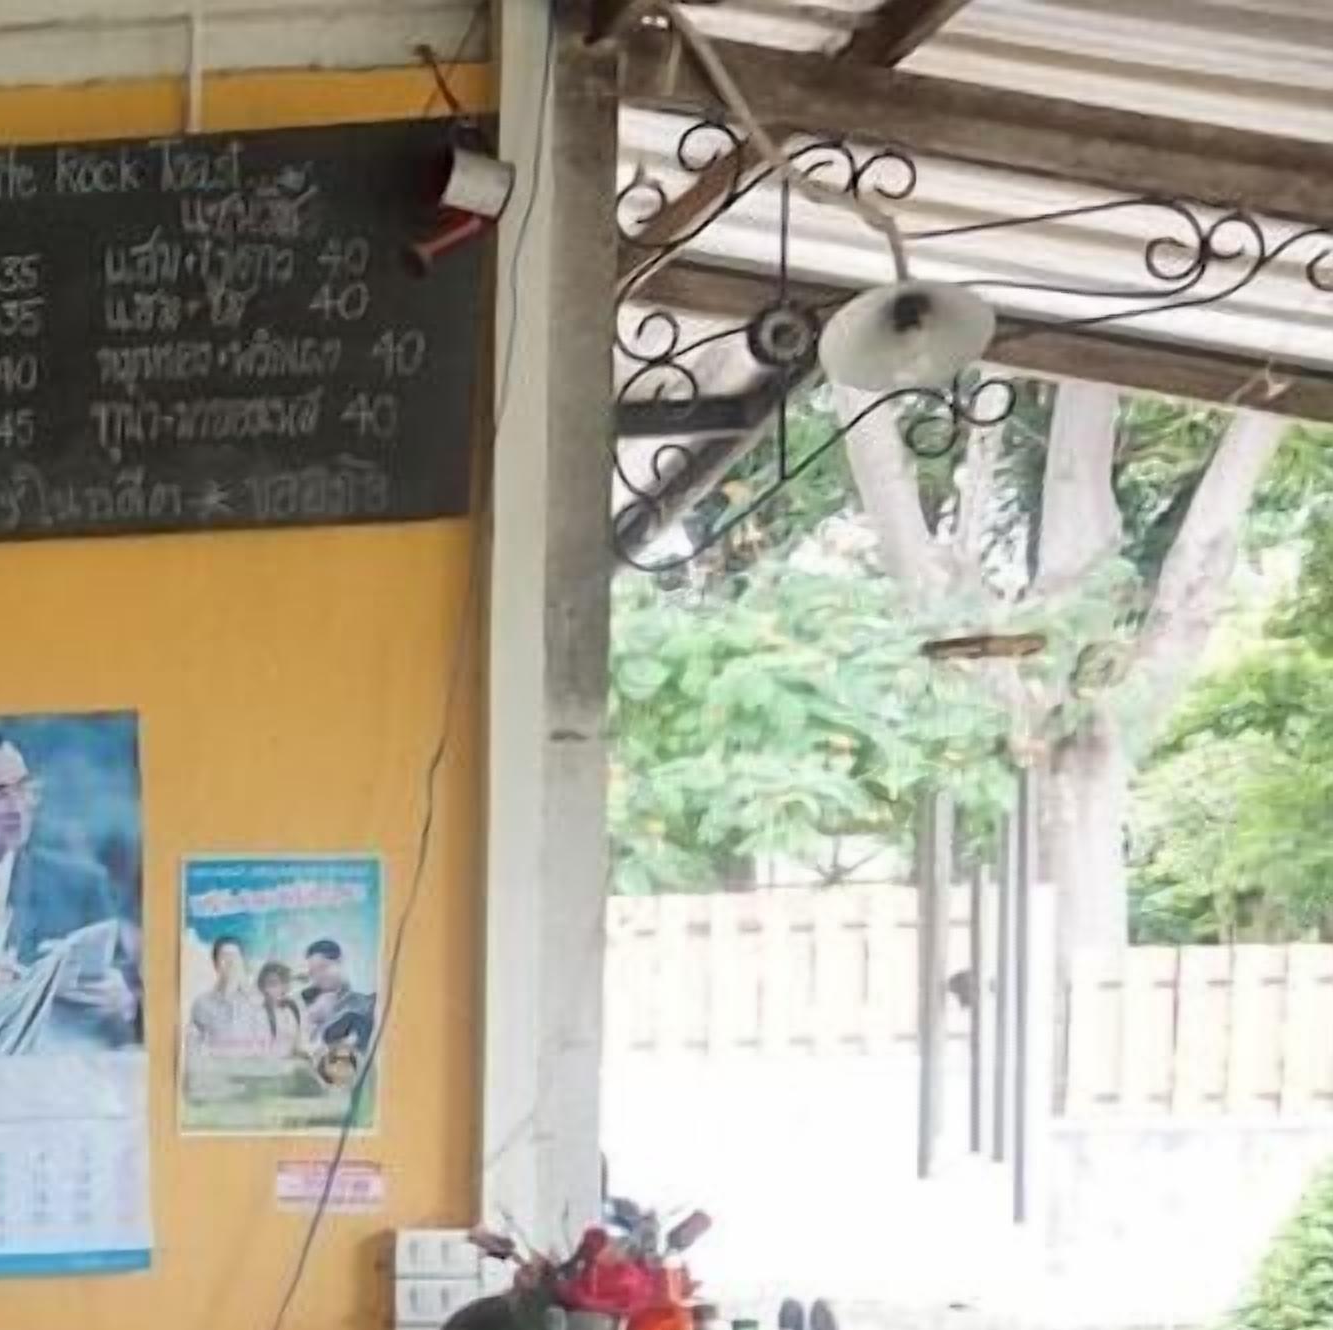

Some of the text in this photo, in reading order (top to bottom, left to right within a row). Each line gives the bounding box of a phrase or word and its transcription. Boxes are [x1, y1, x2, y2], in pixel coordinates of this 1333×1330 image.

[317, 237, 371, 280] 40
[310, 281, 371, 321] 40
[372, 329, 426, 377] 40
[341, 392, 398, 440] 40
